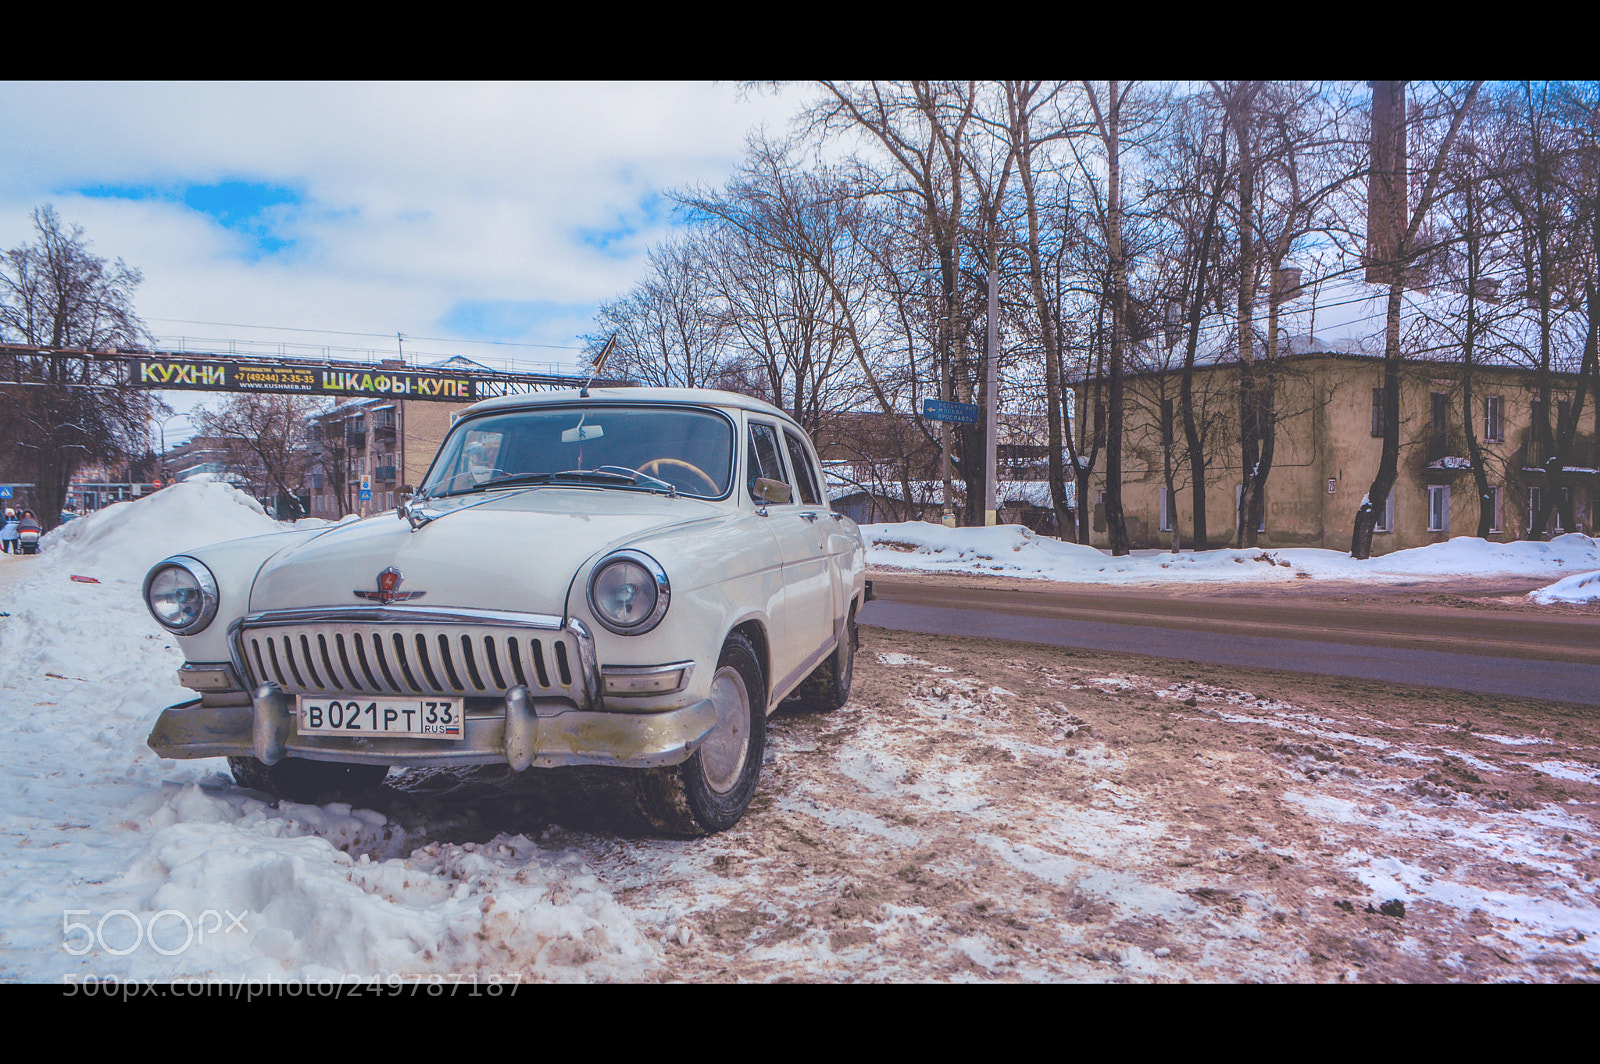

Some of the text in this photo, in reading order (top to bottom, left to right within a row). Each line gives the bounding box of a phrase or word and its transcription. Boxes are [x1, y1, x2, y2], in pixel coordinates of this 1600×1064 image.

[140, 362, 226, 385] КУХНИ
[234, 372, 315, 383] +7 (49244) 2-35-35
[239, 382, 312, 390] WWW.KUSHMEB.RU
[322, 371, 470, 397] ШКАФЫ-КУПЕ
[425, 702, 453, 724] 33
[425, 725, 446, 734] RUS
